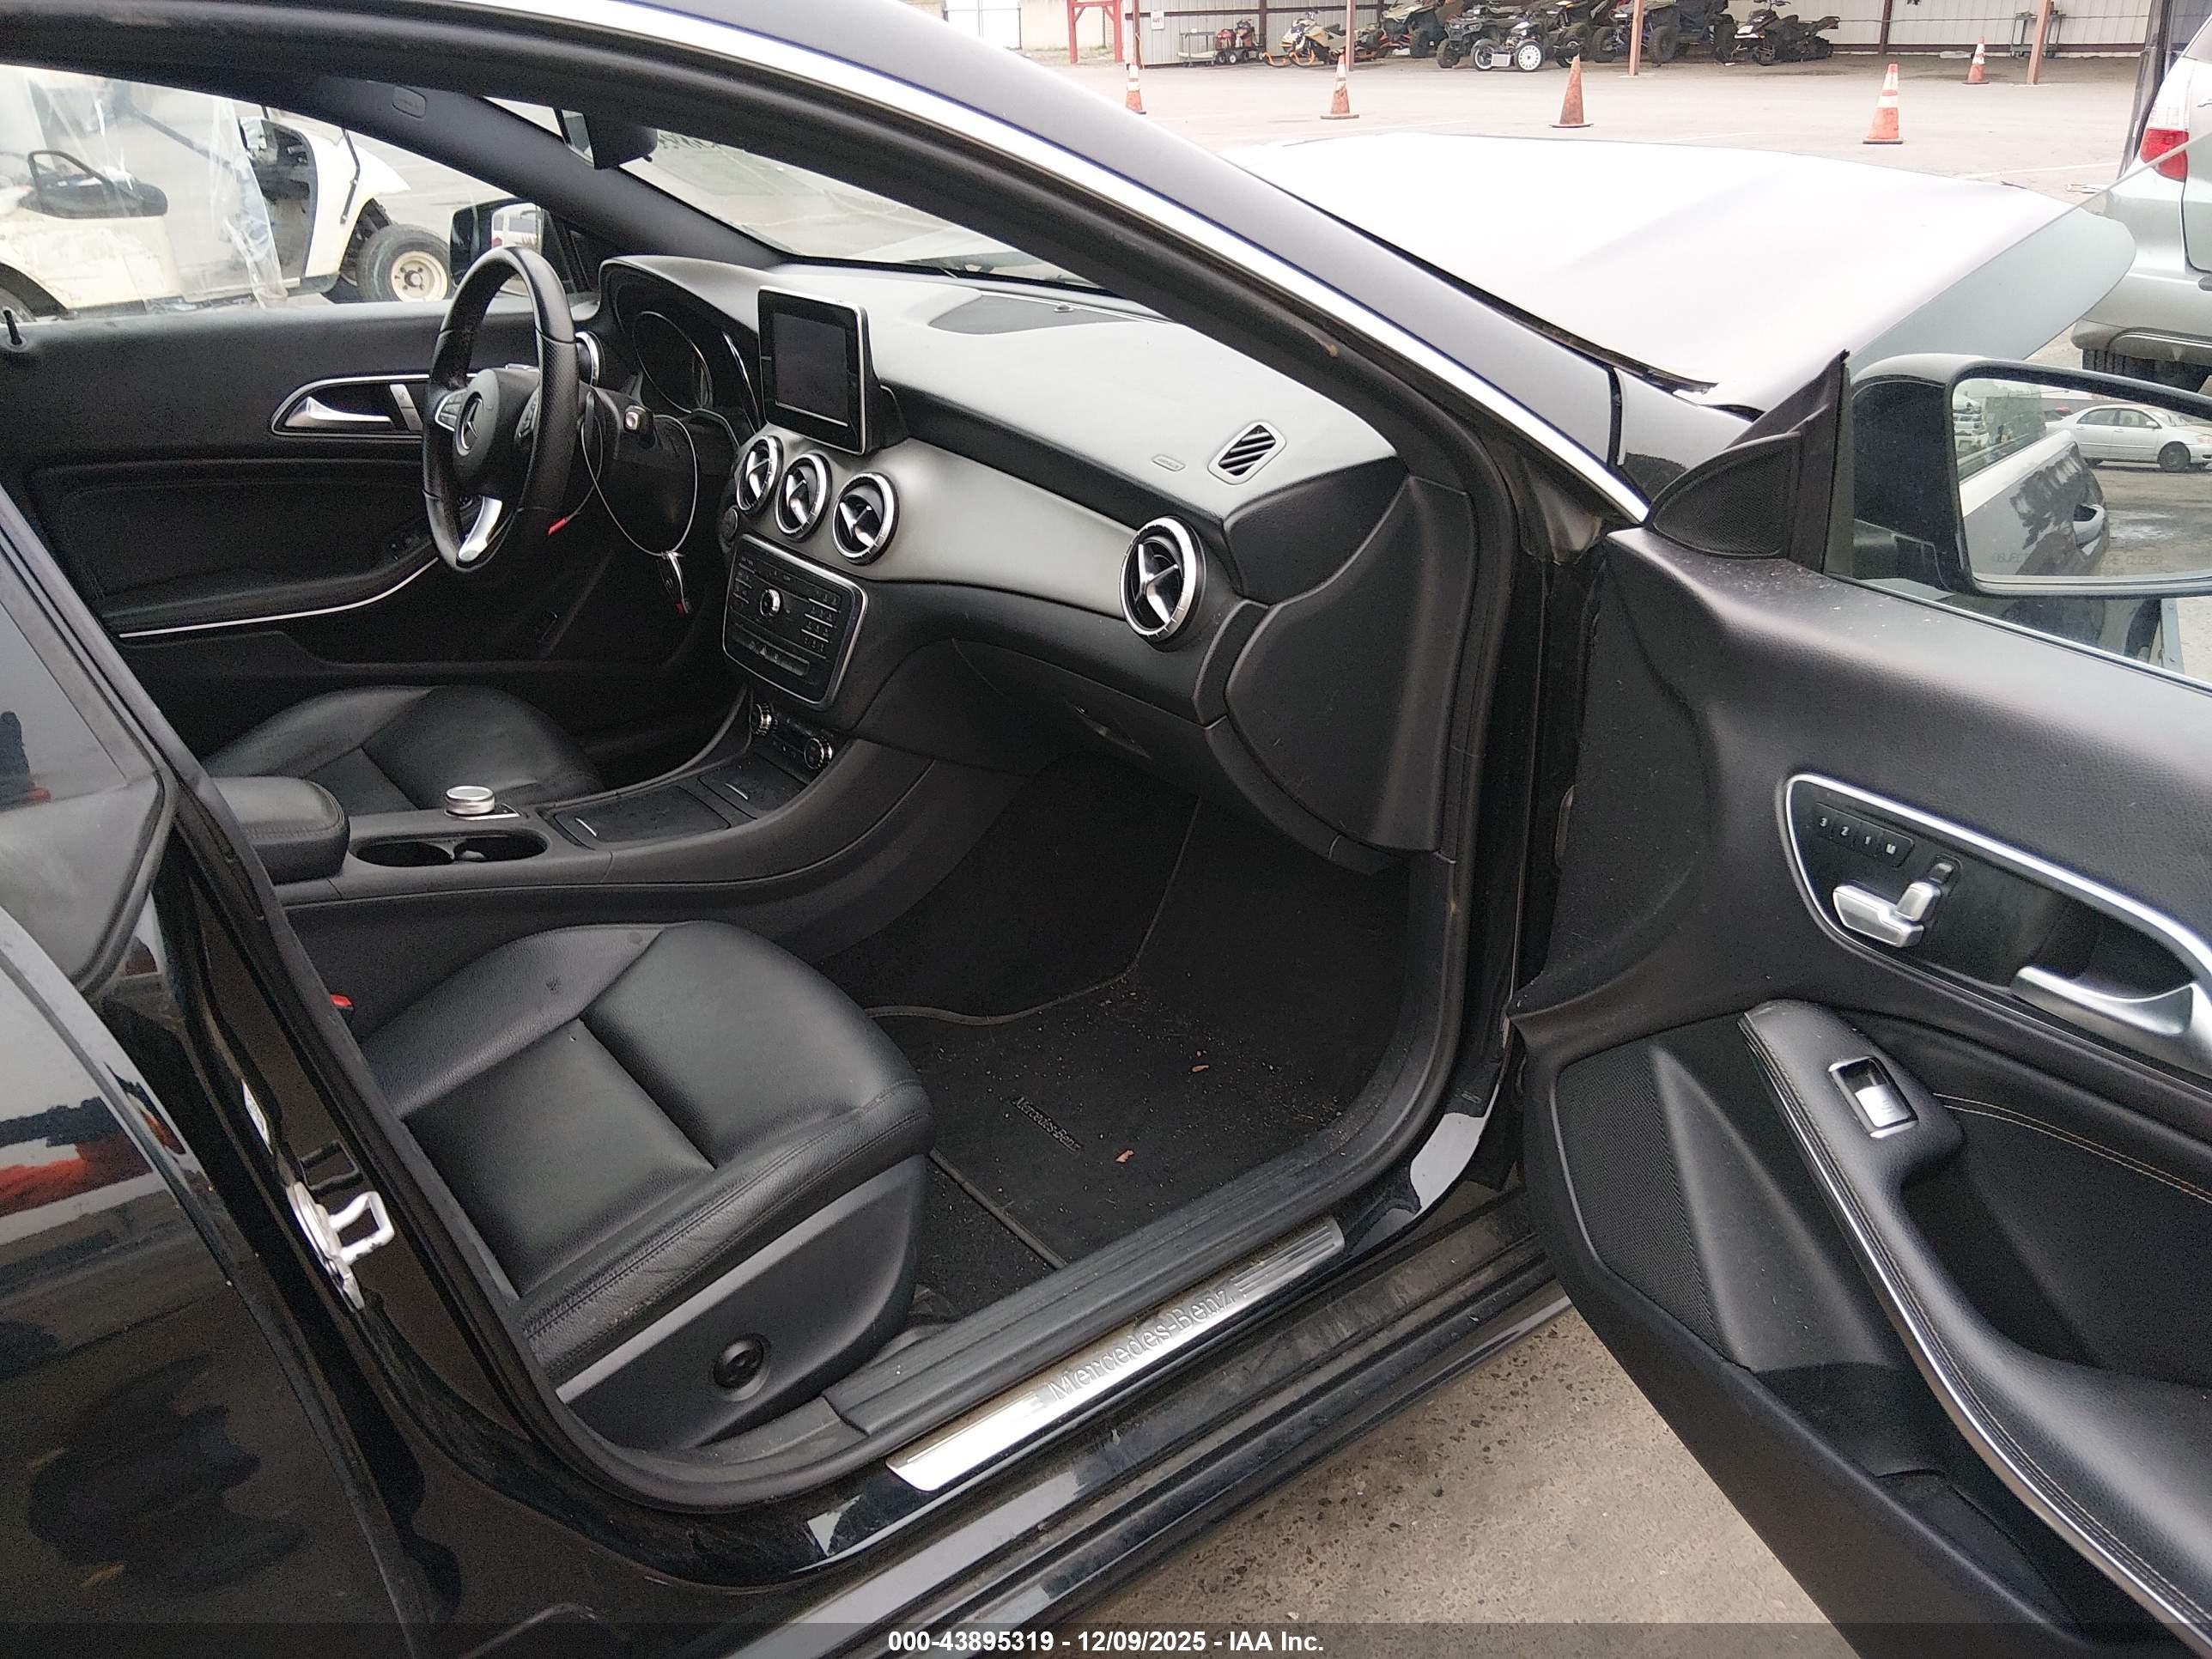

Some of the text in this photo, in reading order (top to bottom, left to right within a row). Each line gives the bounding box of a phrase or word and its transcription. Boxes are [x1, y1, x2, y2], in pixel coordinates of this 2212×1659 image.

[1820, 817, 1896, 854] 3 2 1 M
[1046, 1286, 1237, 1401] Mercedes-Benz
